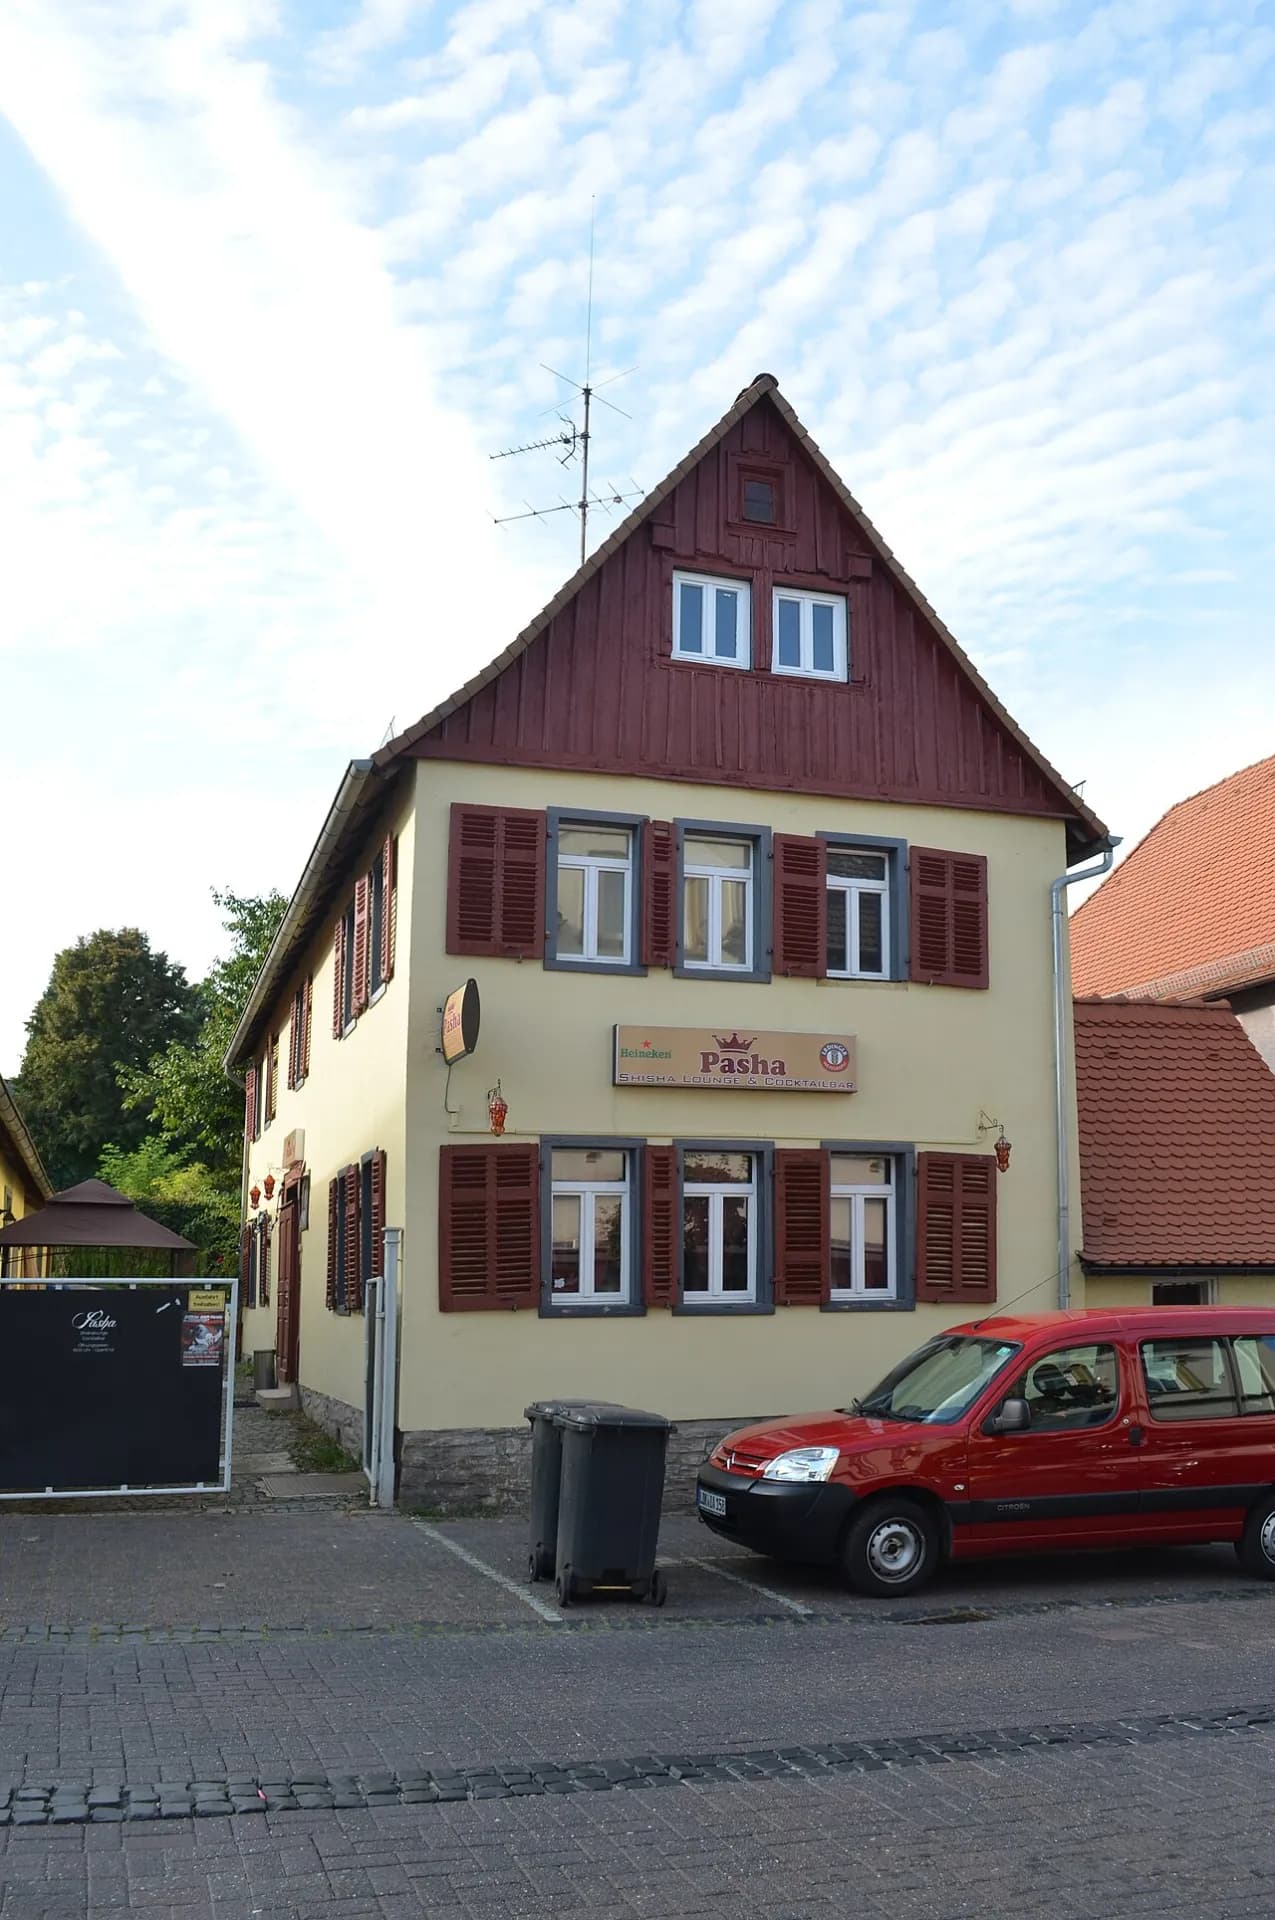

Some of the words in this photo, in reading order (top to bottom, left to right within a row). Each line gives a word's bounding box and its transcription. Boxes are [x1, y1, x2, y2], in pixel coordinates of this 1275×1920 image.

[620, 1048, 672, 1059] Heineken
[700, 1051, 786, 1076] Pasha
[619, 1073, 676, 1082] SHISHA
[683, 1075, 740, 1084] LOUNGE
[747, 1077, 757, 1085] &
[765, 1077, 855, 1088] COCKTAILBAR
